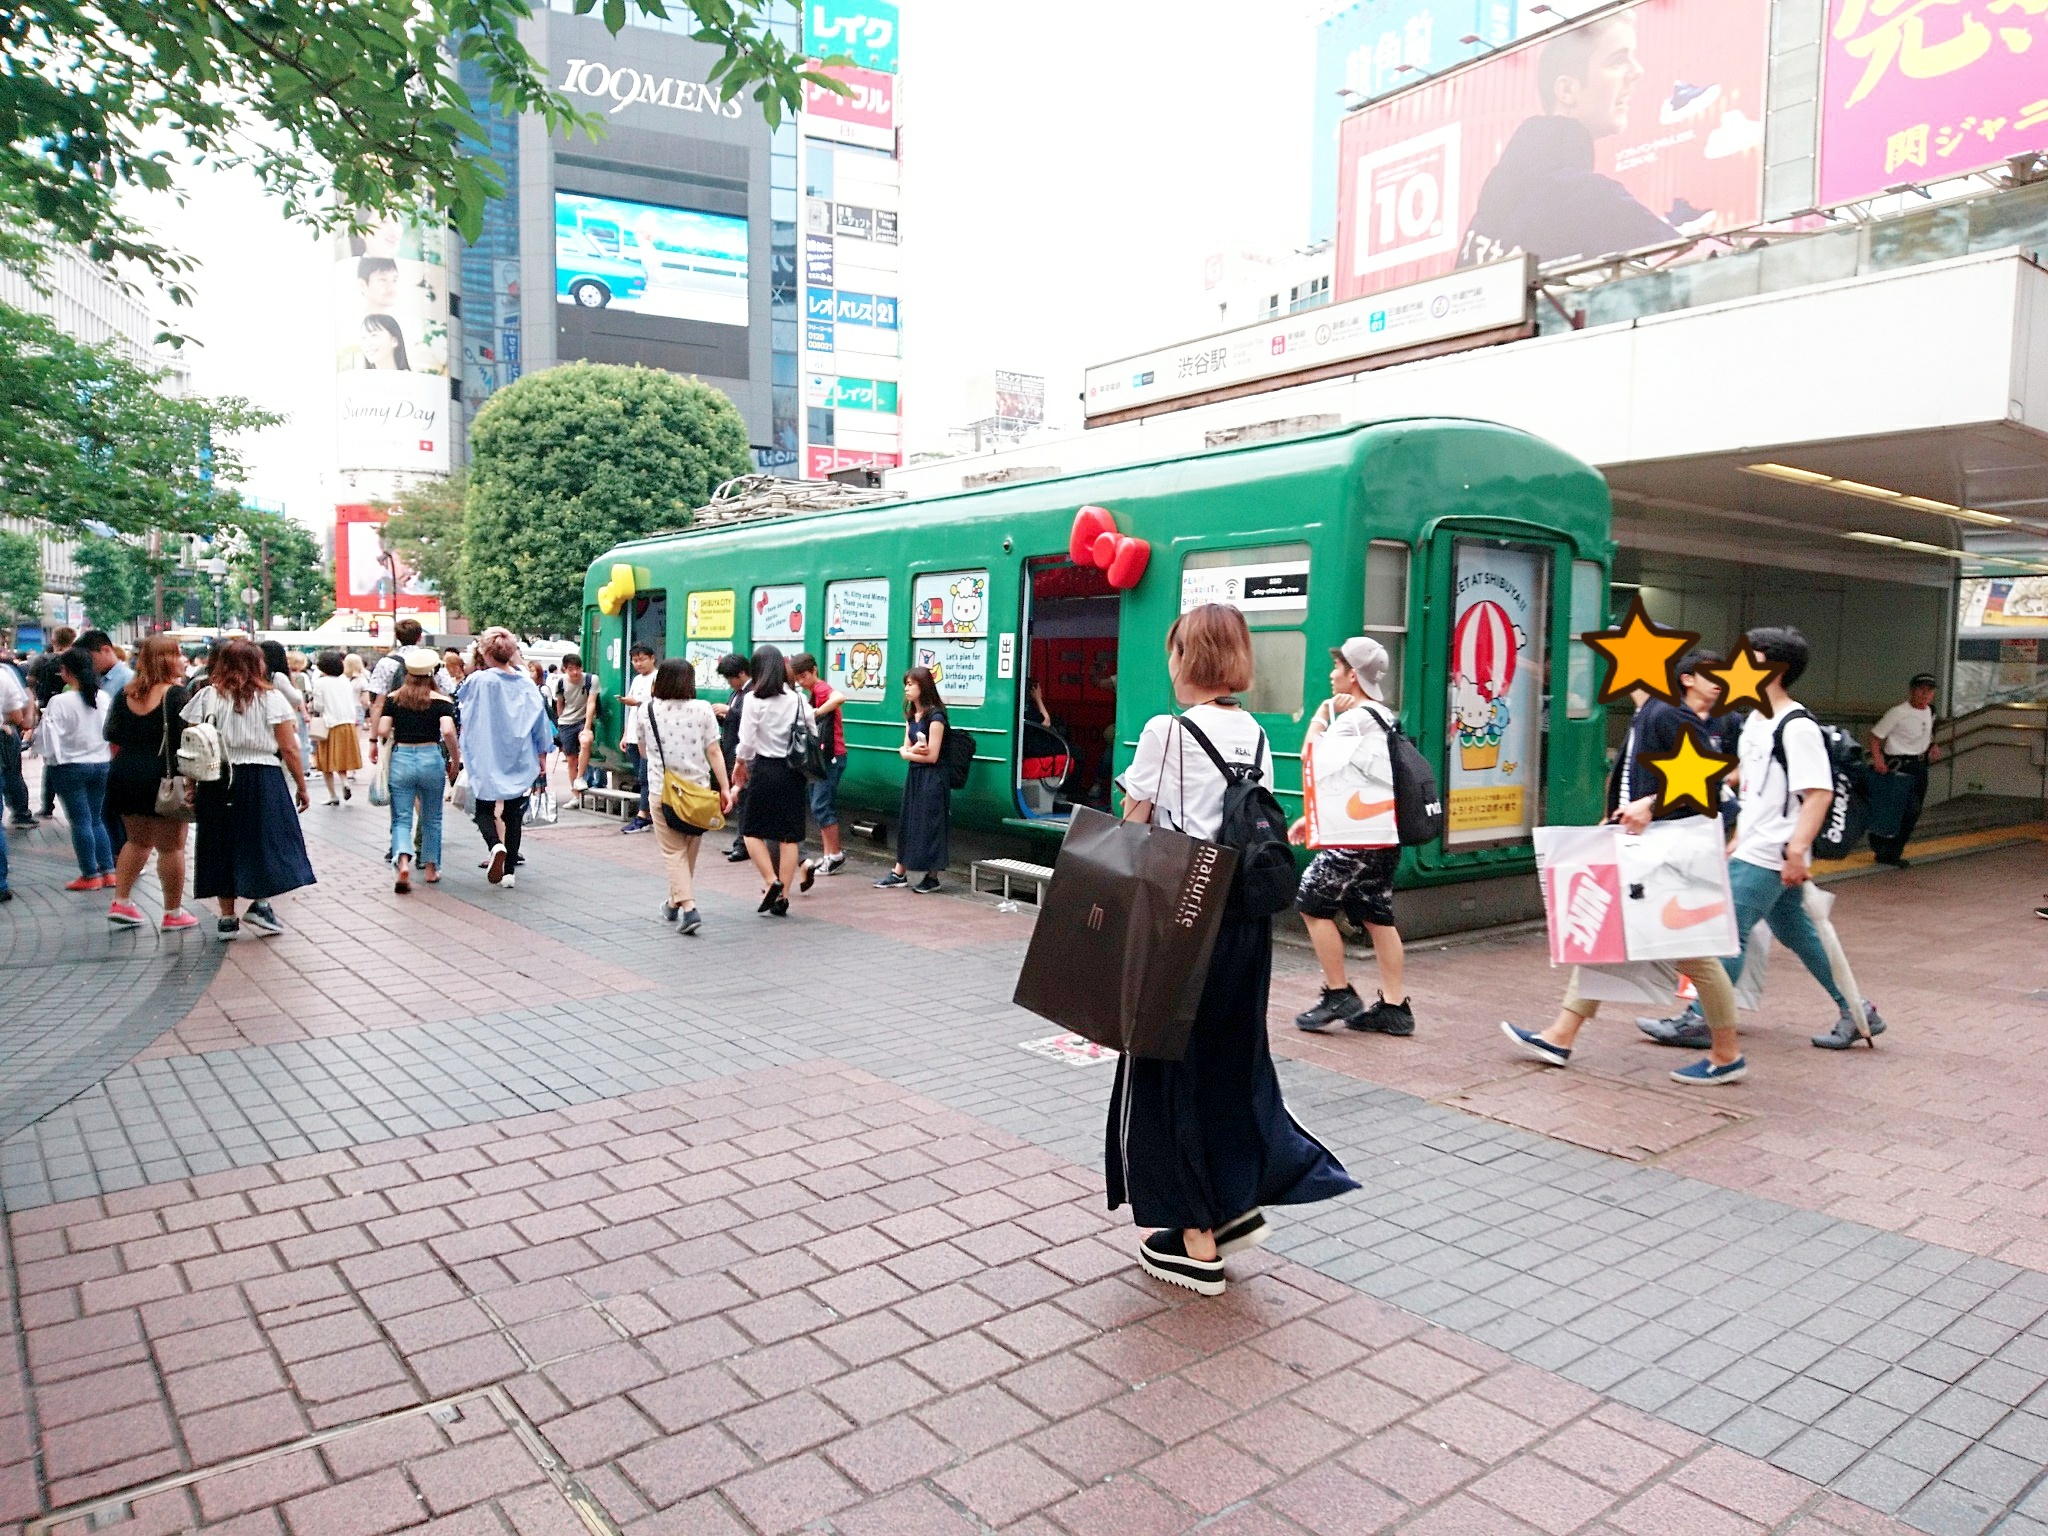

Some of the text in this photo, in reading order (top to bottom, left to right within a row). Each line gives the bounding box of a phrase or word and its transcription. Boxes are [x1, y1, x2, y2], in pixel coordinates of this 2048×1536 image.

[813, 5, 892, 48] レイク
[1178, 347, 1227, 379] 渋谷駅
[837, 386, 872, 402] レイク
[343, 396, 436, 431] Sunny Day
[720, 598, 731, 606] CITY
[960, 652, 971, 662] plan
[972, 652, 981, 661] for
[1001, 638, 1012, 672] 出口
[944, 682, 969, 690] shall we?
[945, 672, 967, 682] birthday
[1566, 874, 1614, 955] NIKE
